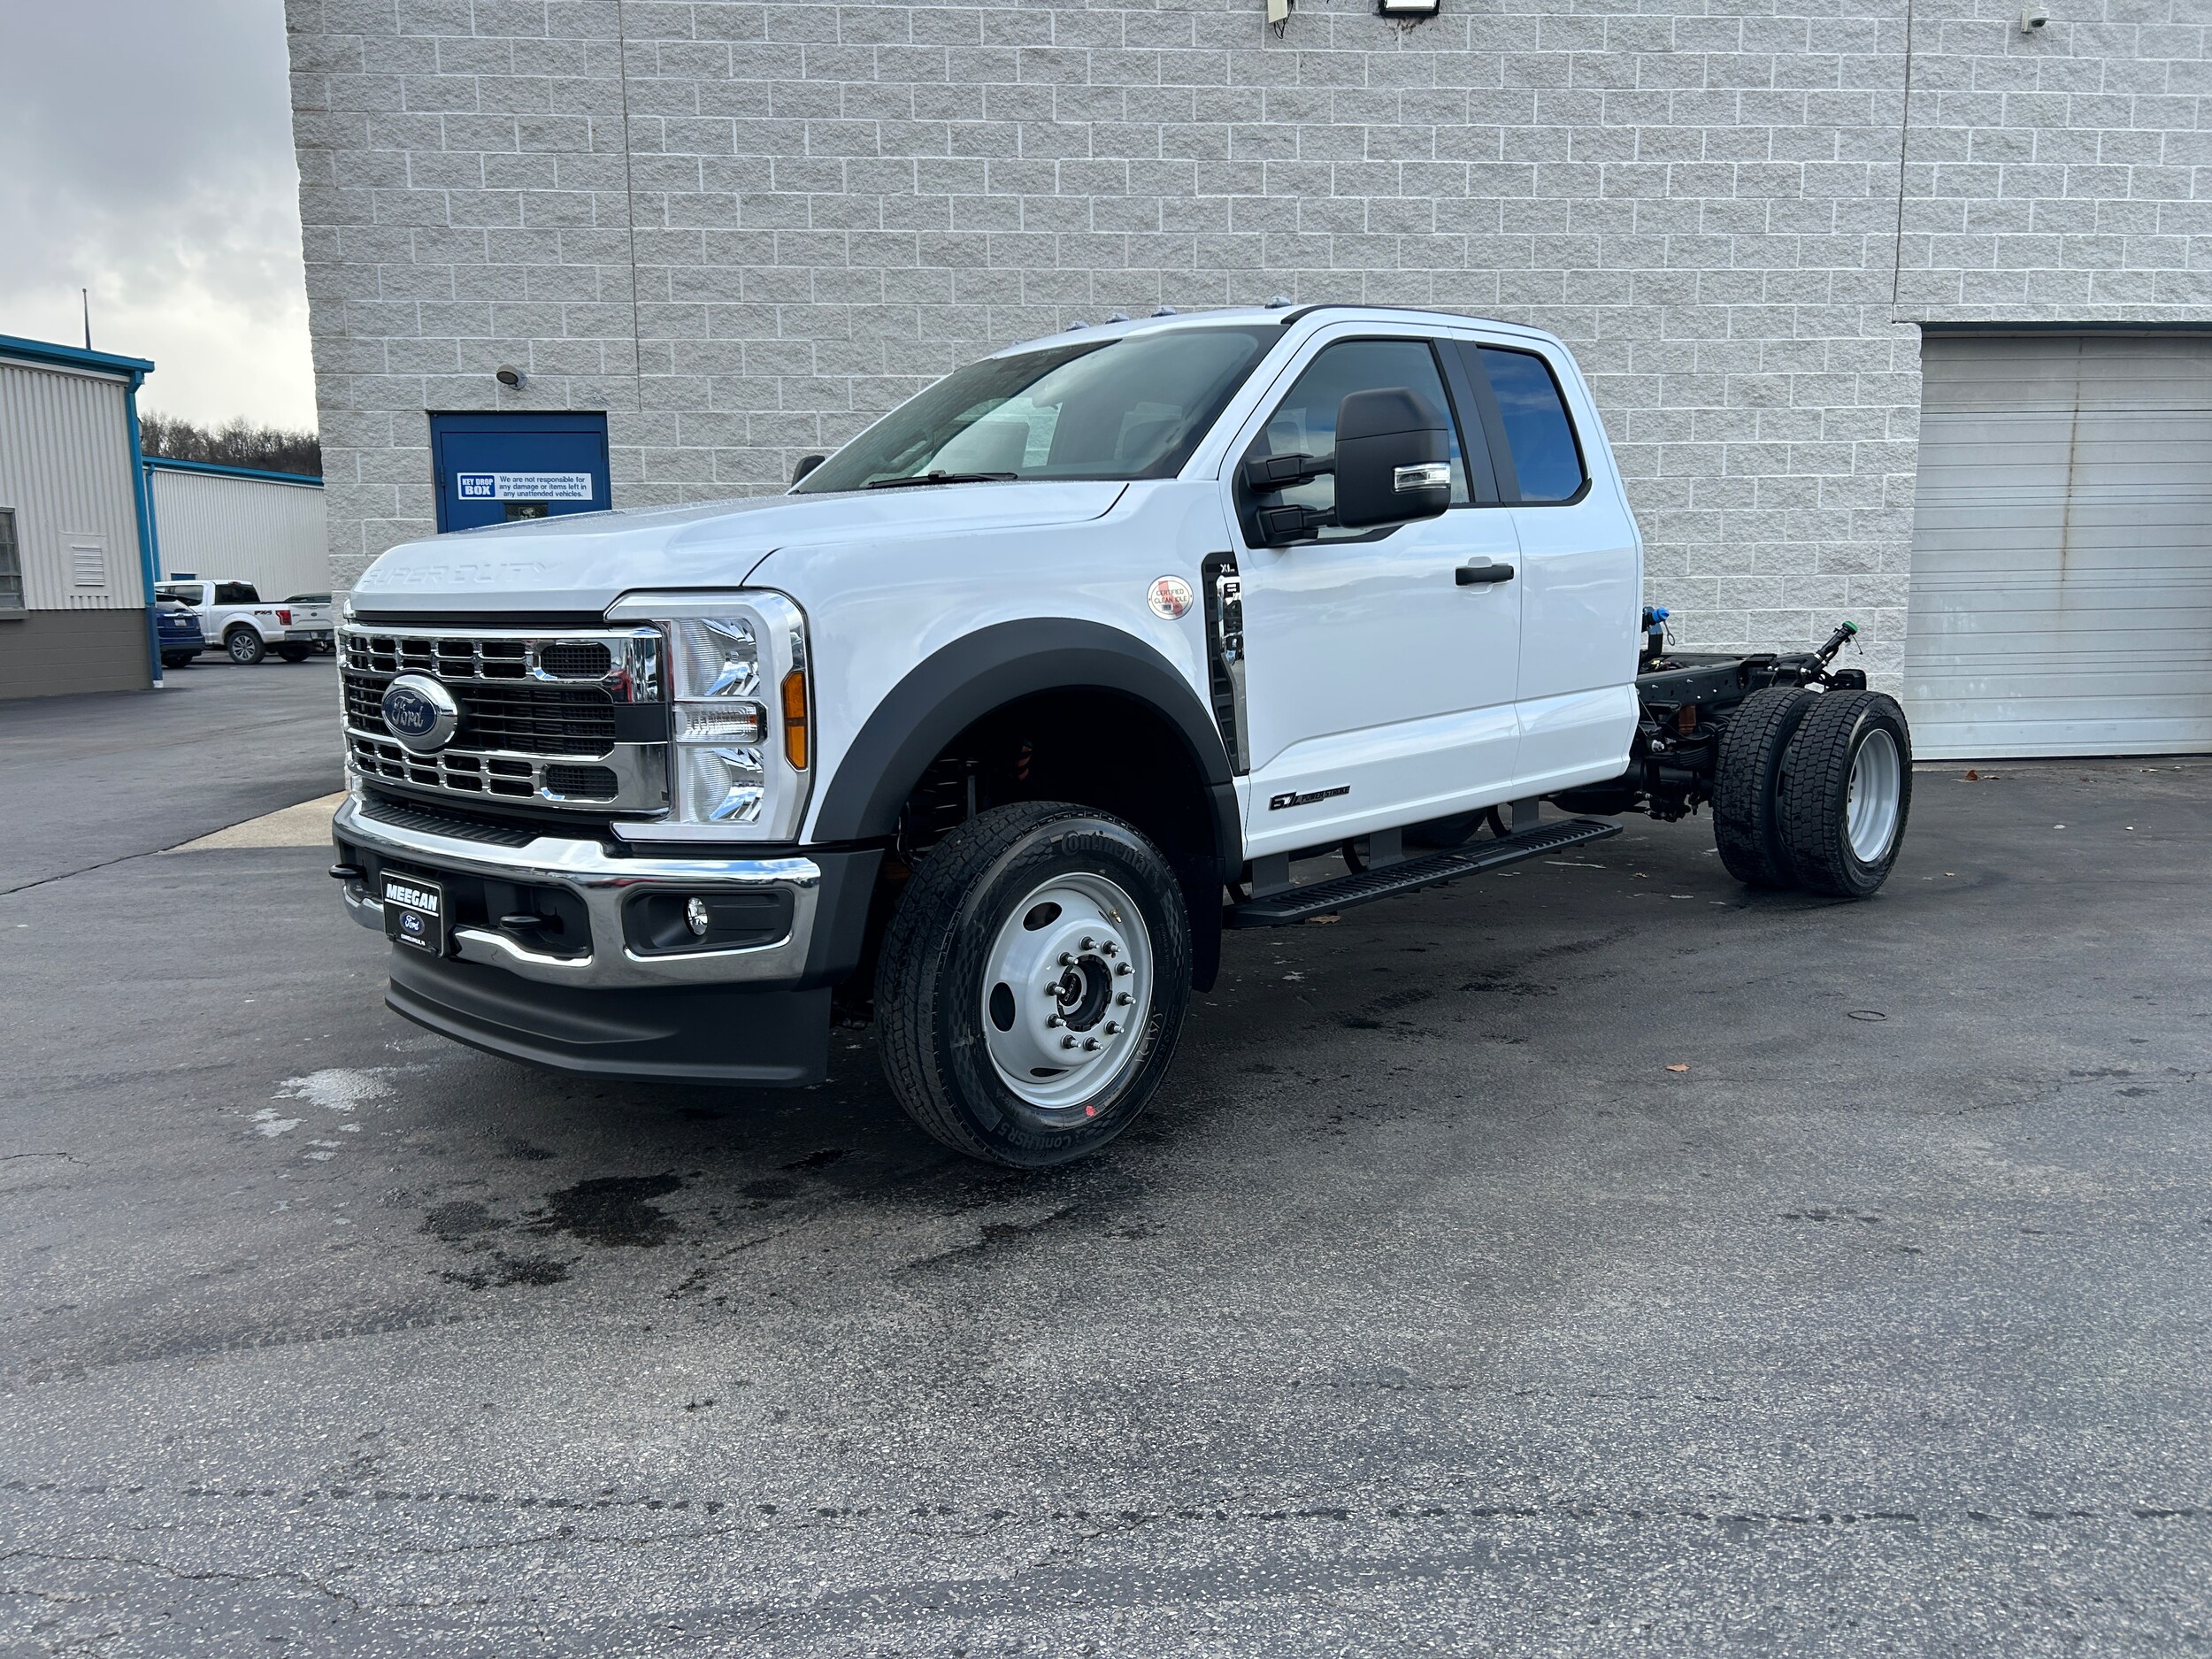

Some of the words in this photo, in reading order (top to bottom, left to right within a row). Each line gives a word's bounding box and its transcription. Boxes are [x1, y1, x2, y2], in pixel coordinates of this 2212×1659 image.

[513, 483, 539, 492] damage
[536, 475, 574, 485] responsible
[465, 485, 491, 495] BOX
[361, 565, 449, 585] SUPER
[447, 561, 563, 584] DUTY
[1220, 564, 1235, 573] XL
[391, 695, 425, 728] Ford
[1062, 830, 1153, 879] Continental
[386, 883, 438, 912] MEEGAN
[404, 914, 420, 931] Ford
